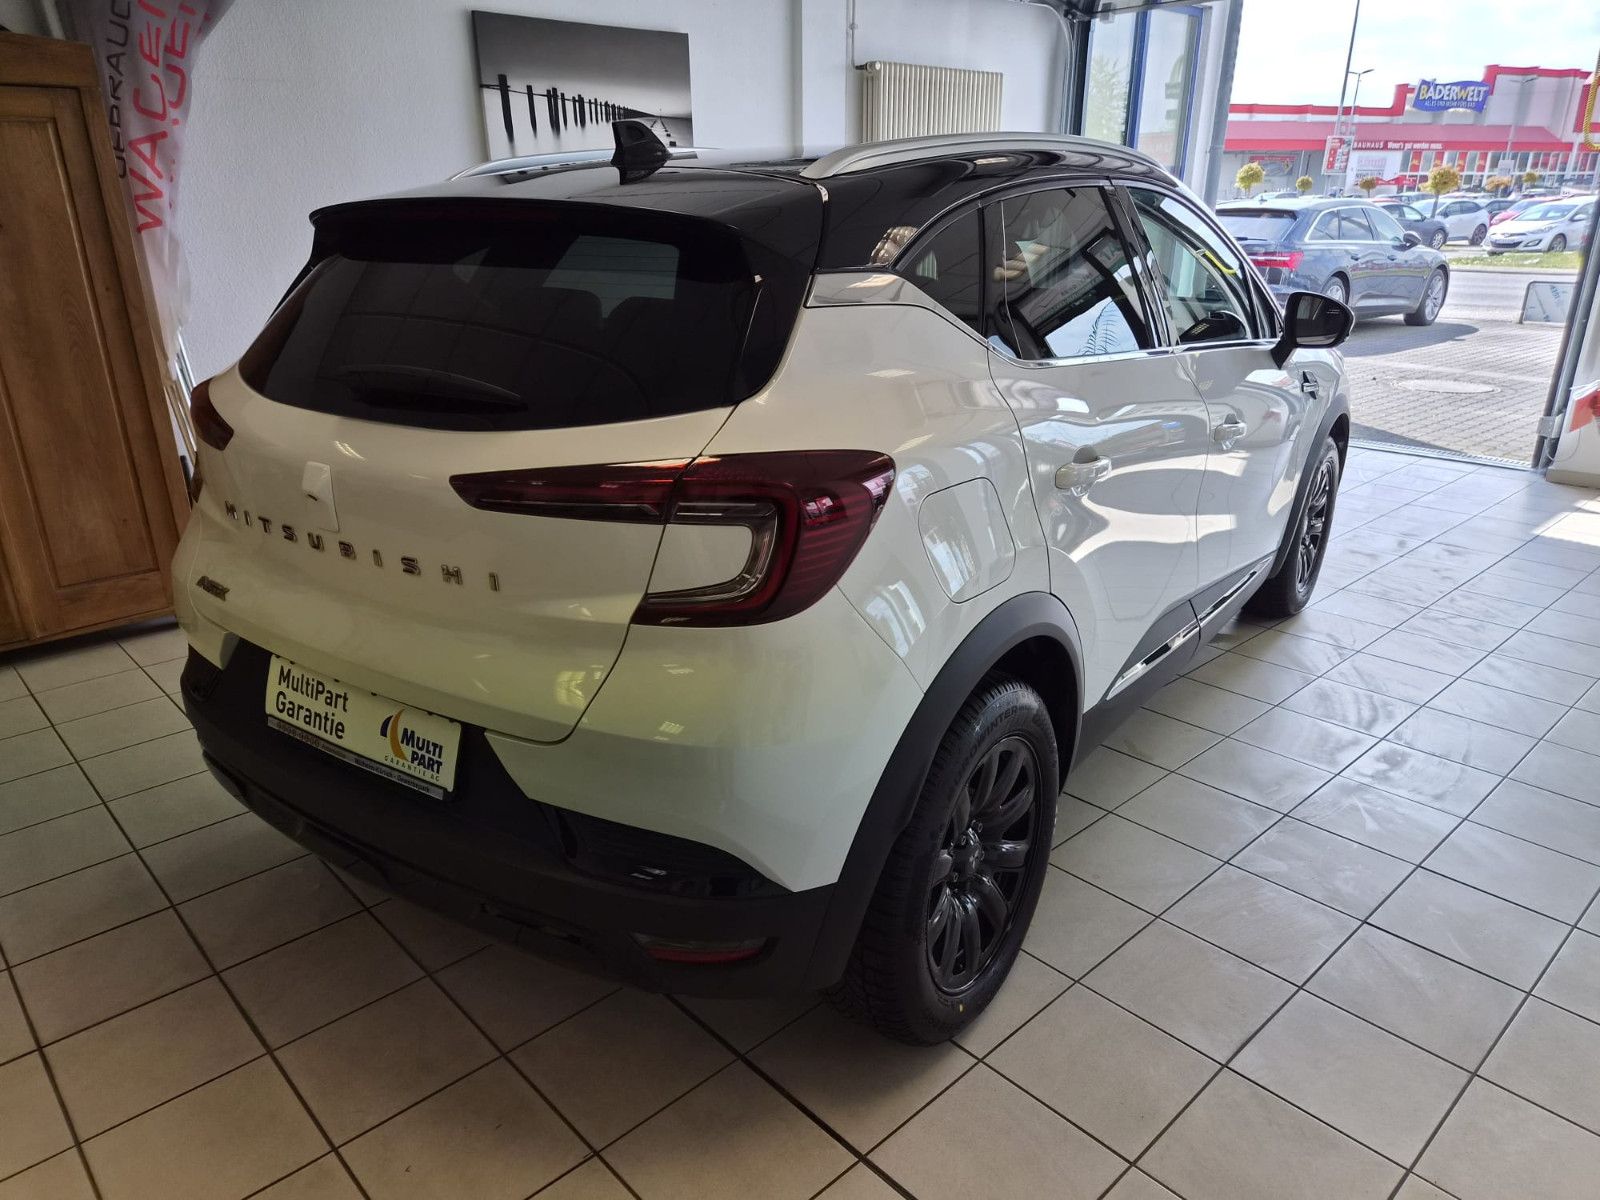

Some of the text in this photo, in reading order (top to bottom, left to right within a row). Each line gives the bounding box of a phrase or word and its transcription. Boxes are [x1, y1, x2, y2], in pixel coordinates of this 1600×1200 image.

[1353, 141, 1384, 150] BAUHAUS
[225, 500, 500, 592] MITSUBISHI
[278, 665, 349, 713] MultiPart
[276, 690, 345, 740] Garantie
[400, 727, 443, 760] MULTI
[410, 751, 443, 775] PART
